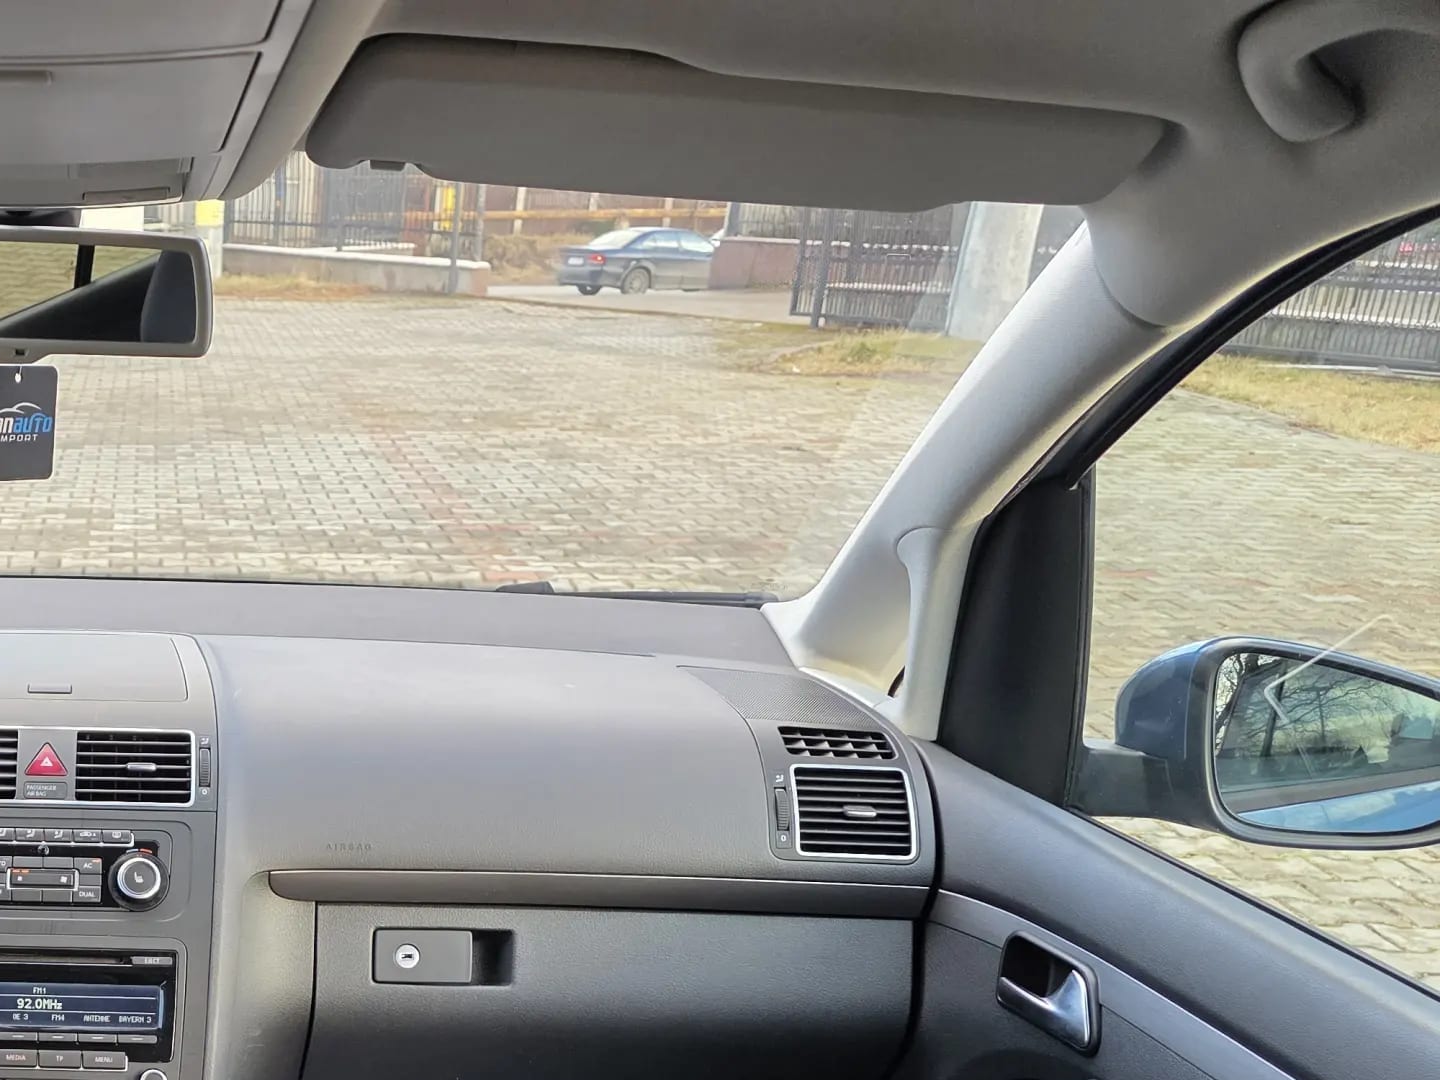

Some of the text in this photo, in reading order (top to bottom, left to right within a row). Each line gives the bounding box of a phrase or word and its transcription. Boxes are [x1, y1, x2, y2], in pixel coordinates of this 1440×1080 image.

[79, 890, 96, 898] DUAL
[32, 986, 47, 995] FM1
[16, 998, 63, 1010] 92.0MHz
[51, 1013, 65, 1022] FM4
[6, 1053, 27, 1061] MEDIA
